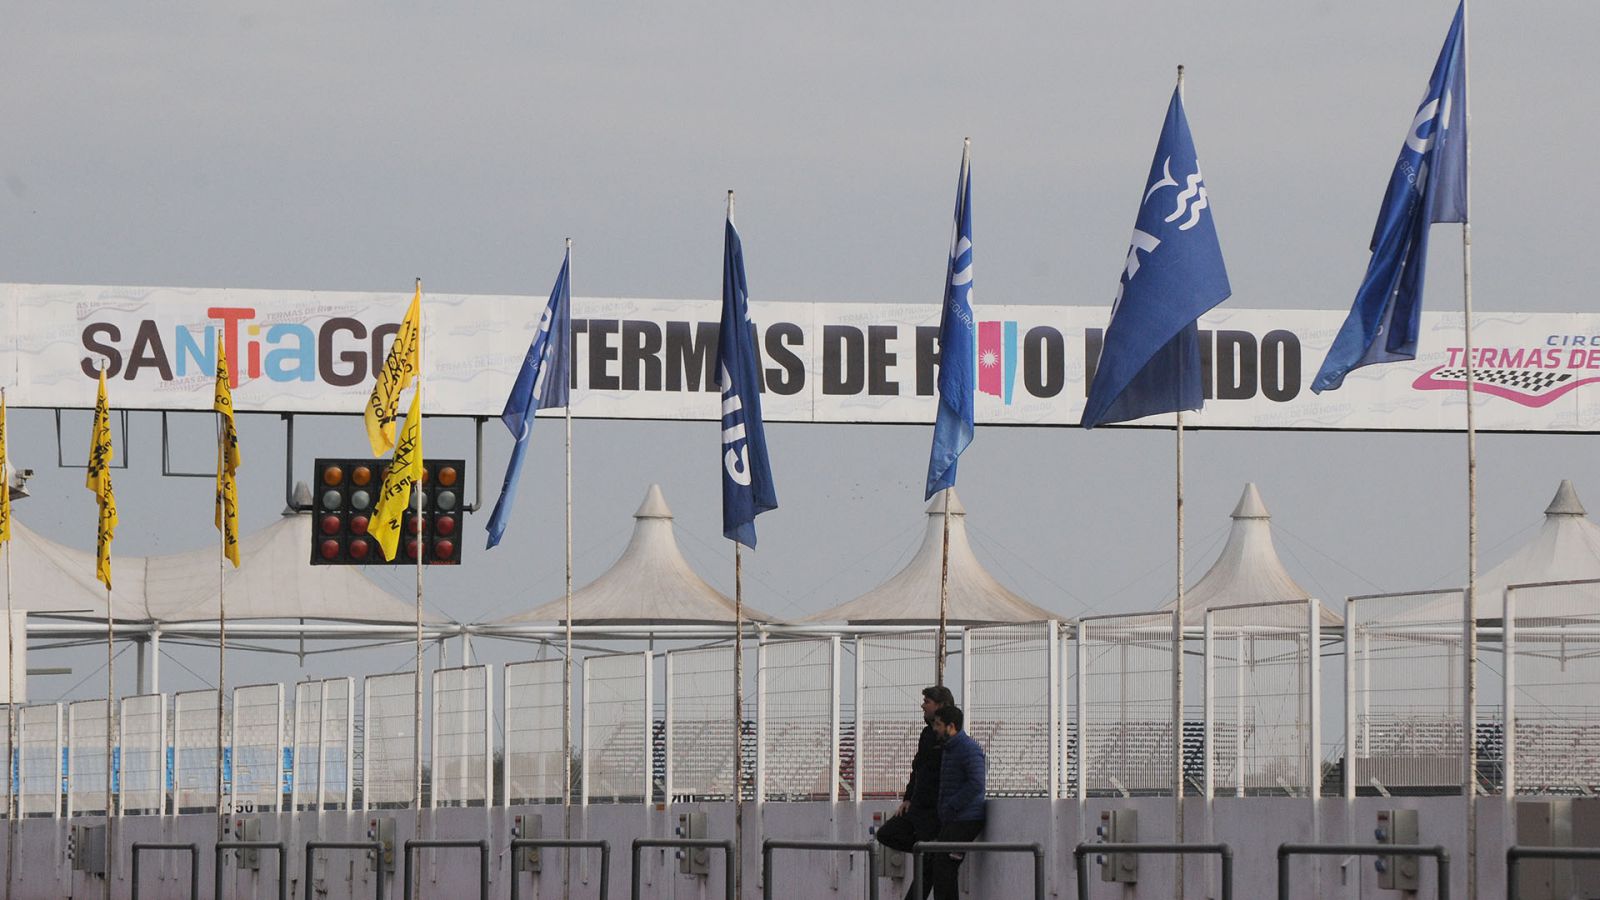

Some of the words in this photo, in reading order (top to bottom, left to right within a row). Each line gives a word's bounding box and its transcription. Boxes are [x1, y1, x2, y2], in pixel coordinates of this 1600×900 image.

[822, 325, 900, 396] DE
[1446, 347, 1562, 369] TERMAS
[1567, 348, 1600, 369] DE
